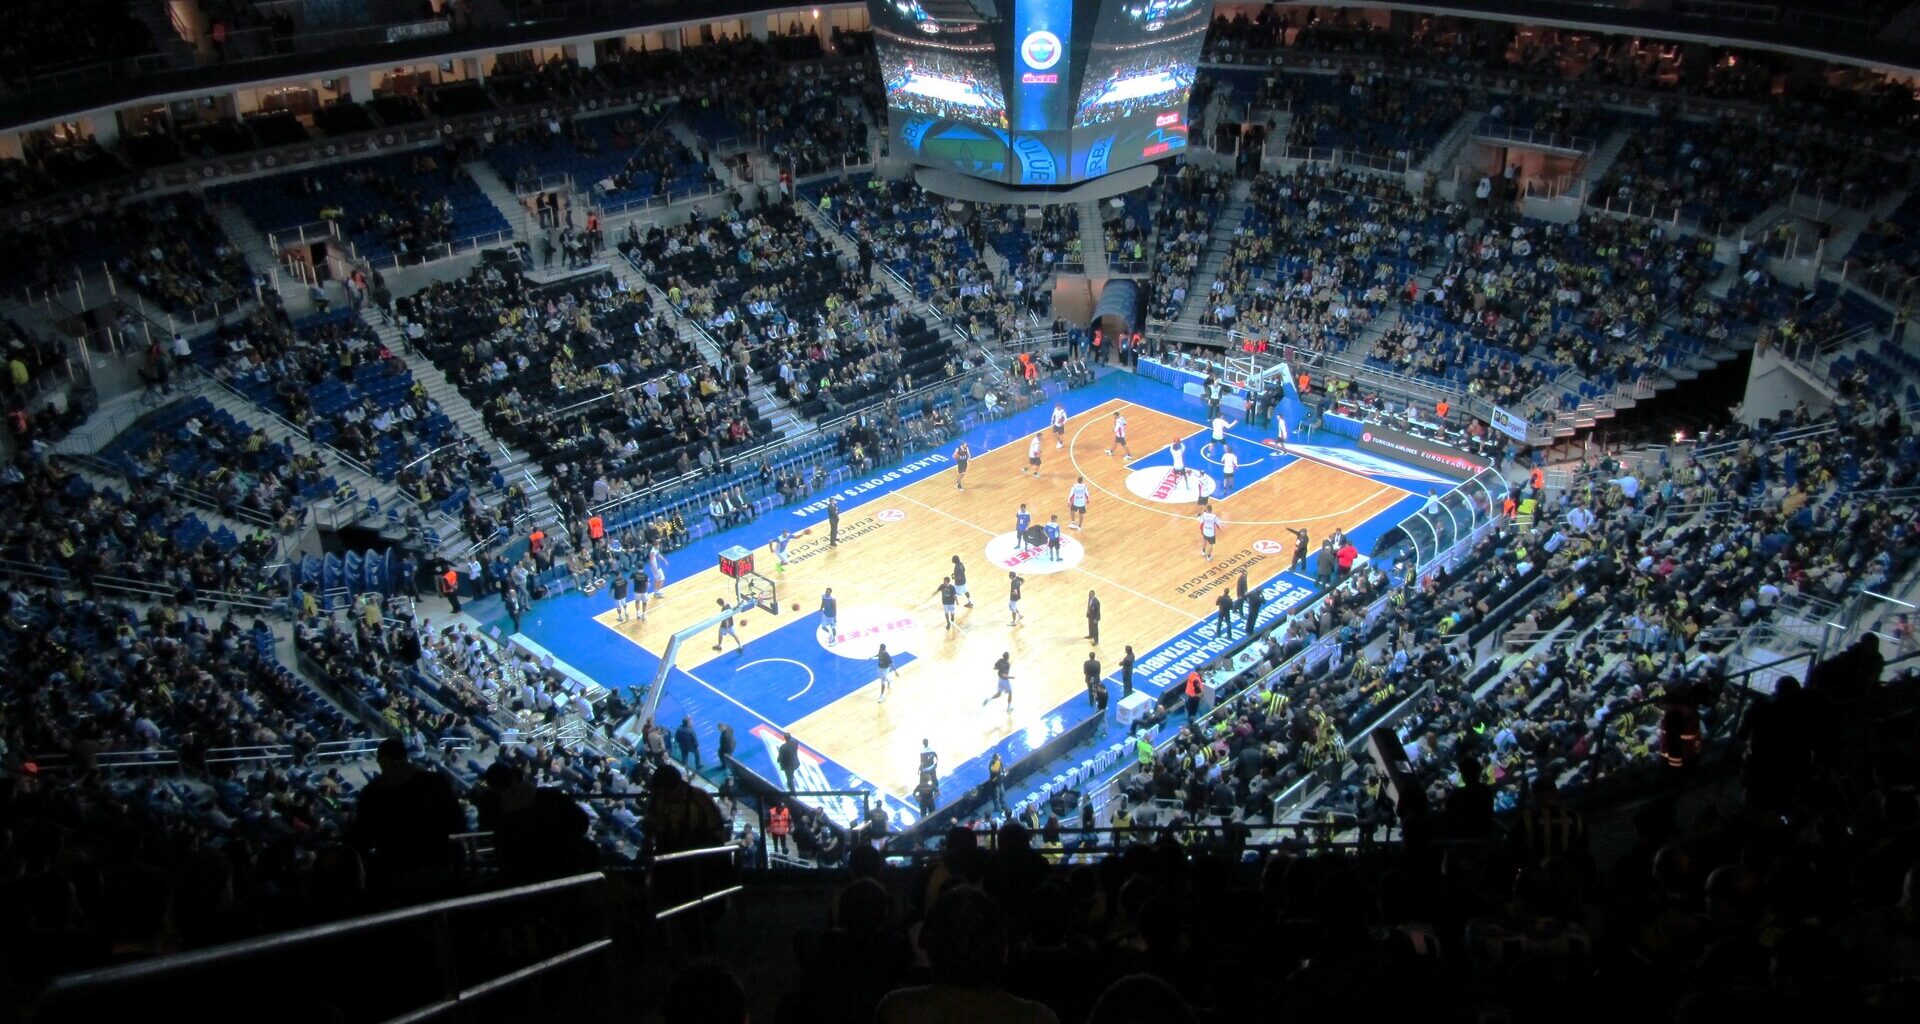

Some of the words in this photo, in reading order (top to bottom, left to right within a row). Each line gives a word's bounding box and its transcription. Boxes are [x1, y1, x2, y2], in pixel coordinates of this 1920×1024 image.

[897, 454, 949, 474] ÜLKER
[1421, 451, 1472, 472] EUROLEAGUE
[844, 471, 901, 497] SPORTS
[786, 517, 874, 558] EUROEAGU
[790, 543, 834, 565] IRLINES
[1174, 549, 1252, 594] EUROLEAGUE
